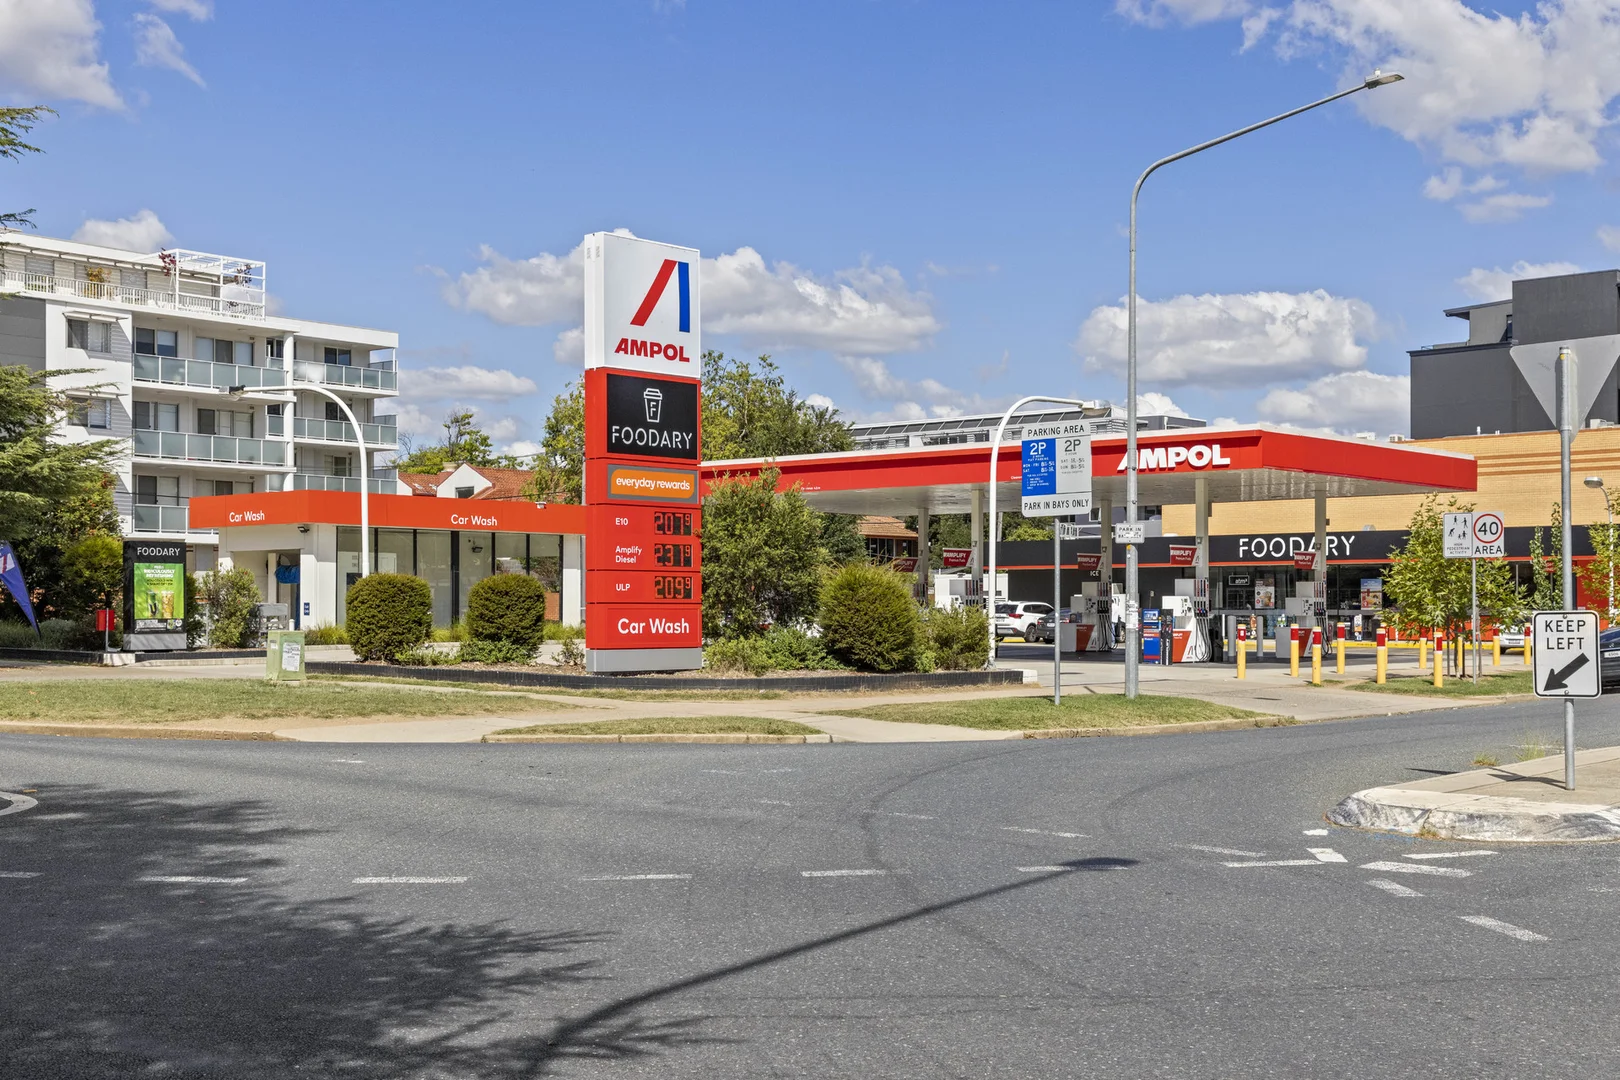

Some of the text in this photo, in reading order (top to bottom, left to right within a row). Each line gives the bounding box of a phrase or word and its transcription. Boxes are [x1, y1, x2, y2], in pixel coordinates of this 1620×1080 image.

[614, 337, 690, 362] AMPOL
[1028, 424, 1084, 437] PARKING AREA
[612, 426, 693, 450] FOODARY
[1030, 442, 1046, 455] 2P
[1064, 439, 1081, 452] 2P
[616, 477, 690, 490] everyday rewards
[1024, 502, 1041, 510] PARK
[1052, 500, 1069, 508] BAYS
[1072, 499, 1089, 507] ONLY
[229, 510, 265, 523] Car Wash
[451, 514, 498, 526] Car Wash
[616, 518, 628, 526] E10
[1478, 522, 1498, 535] 40
[137, 547, 180, 556] FOODARY
[616, 546, 642, 555] Amplify
[1474, 546, 1502, 554] AREA
[616, 555, 636, 564] Diesel
[618, 618, 689, 634] Car Wash
[1545, 620, 1586, 632] KEEP
[1547, 638, 1584, 650] LEFT
